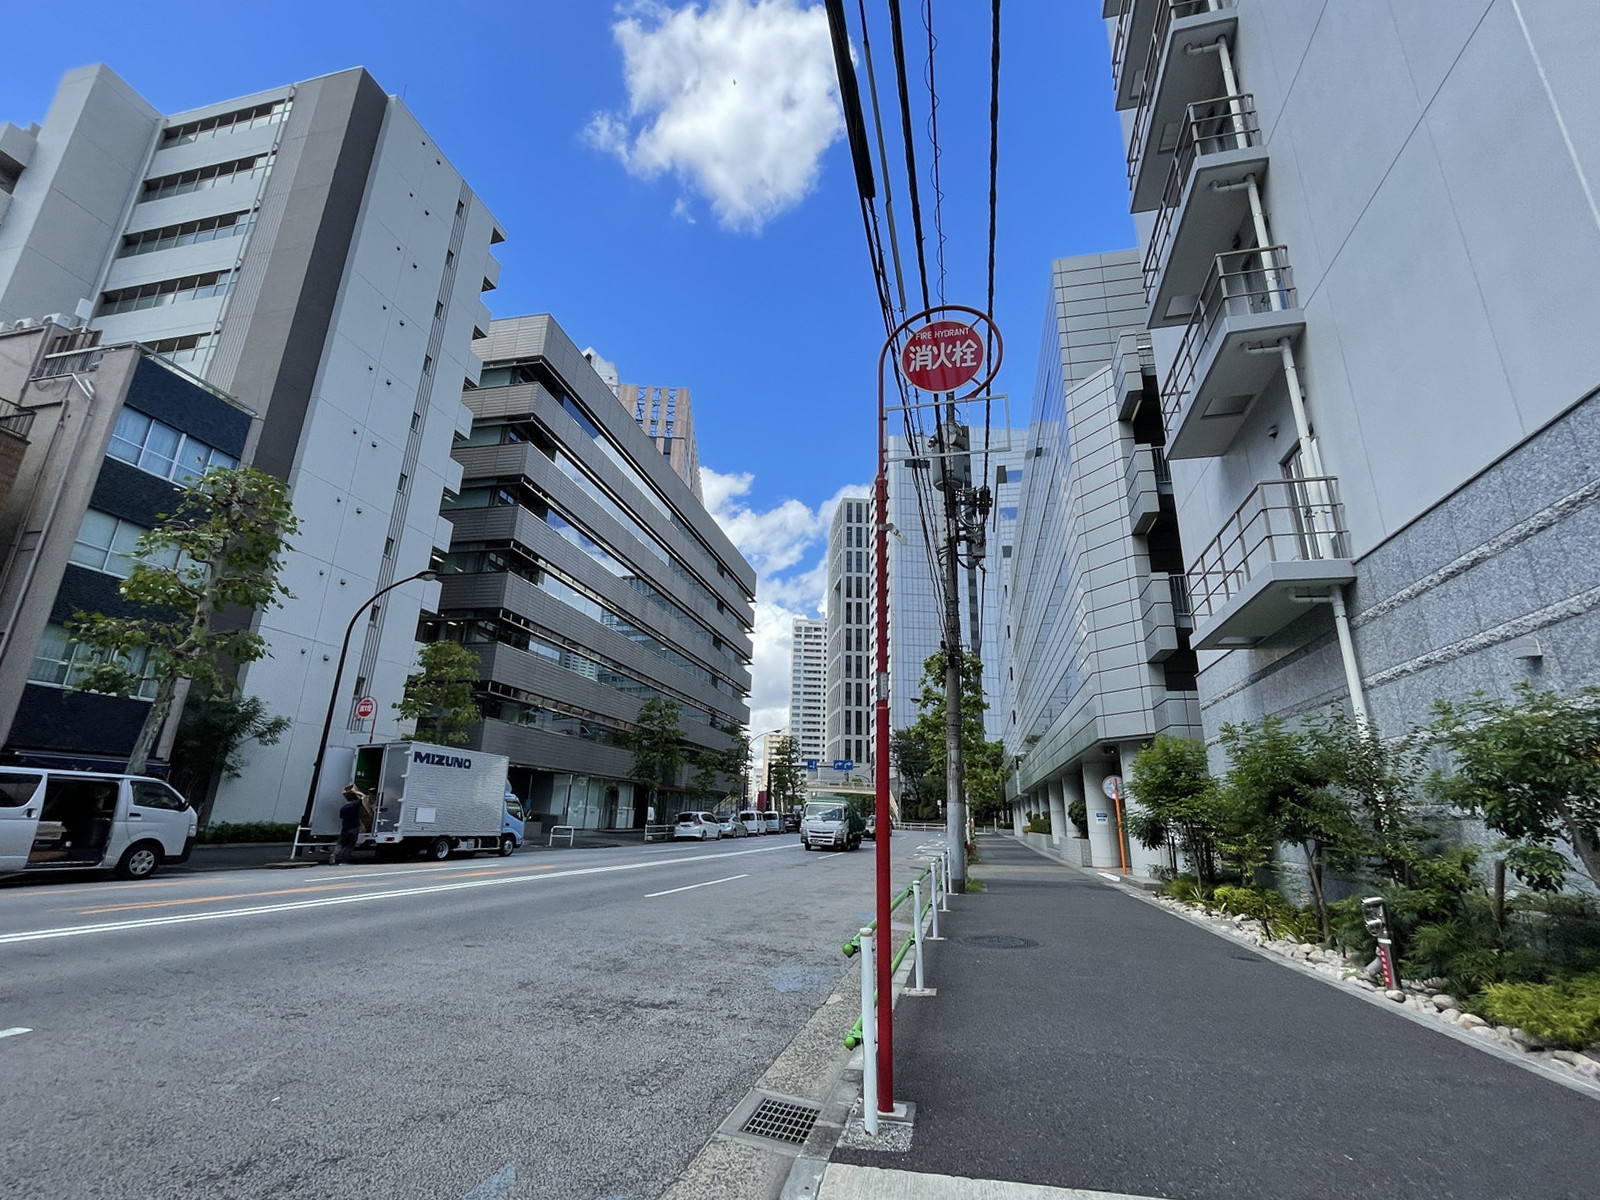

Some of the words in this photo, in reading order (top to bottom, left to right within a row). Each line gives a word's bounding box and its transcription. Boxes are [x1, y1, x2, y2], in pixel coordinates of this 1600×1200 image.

[915, 331, 932, 340] FIRE
[934, 327, 969, 339] HYDRANT
[909, 339, 977, 372] 消火栓
[413, 751, 472, 769] MIZUNO
